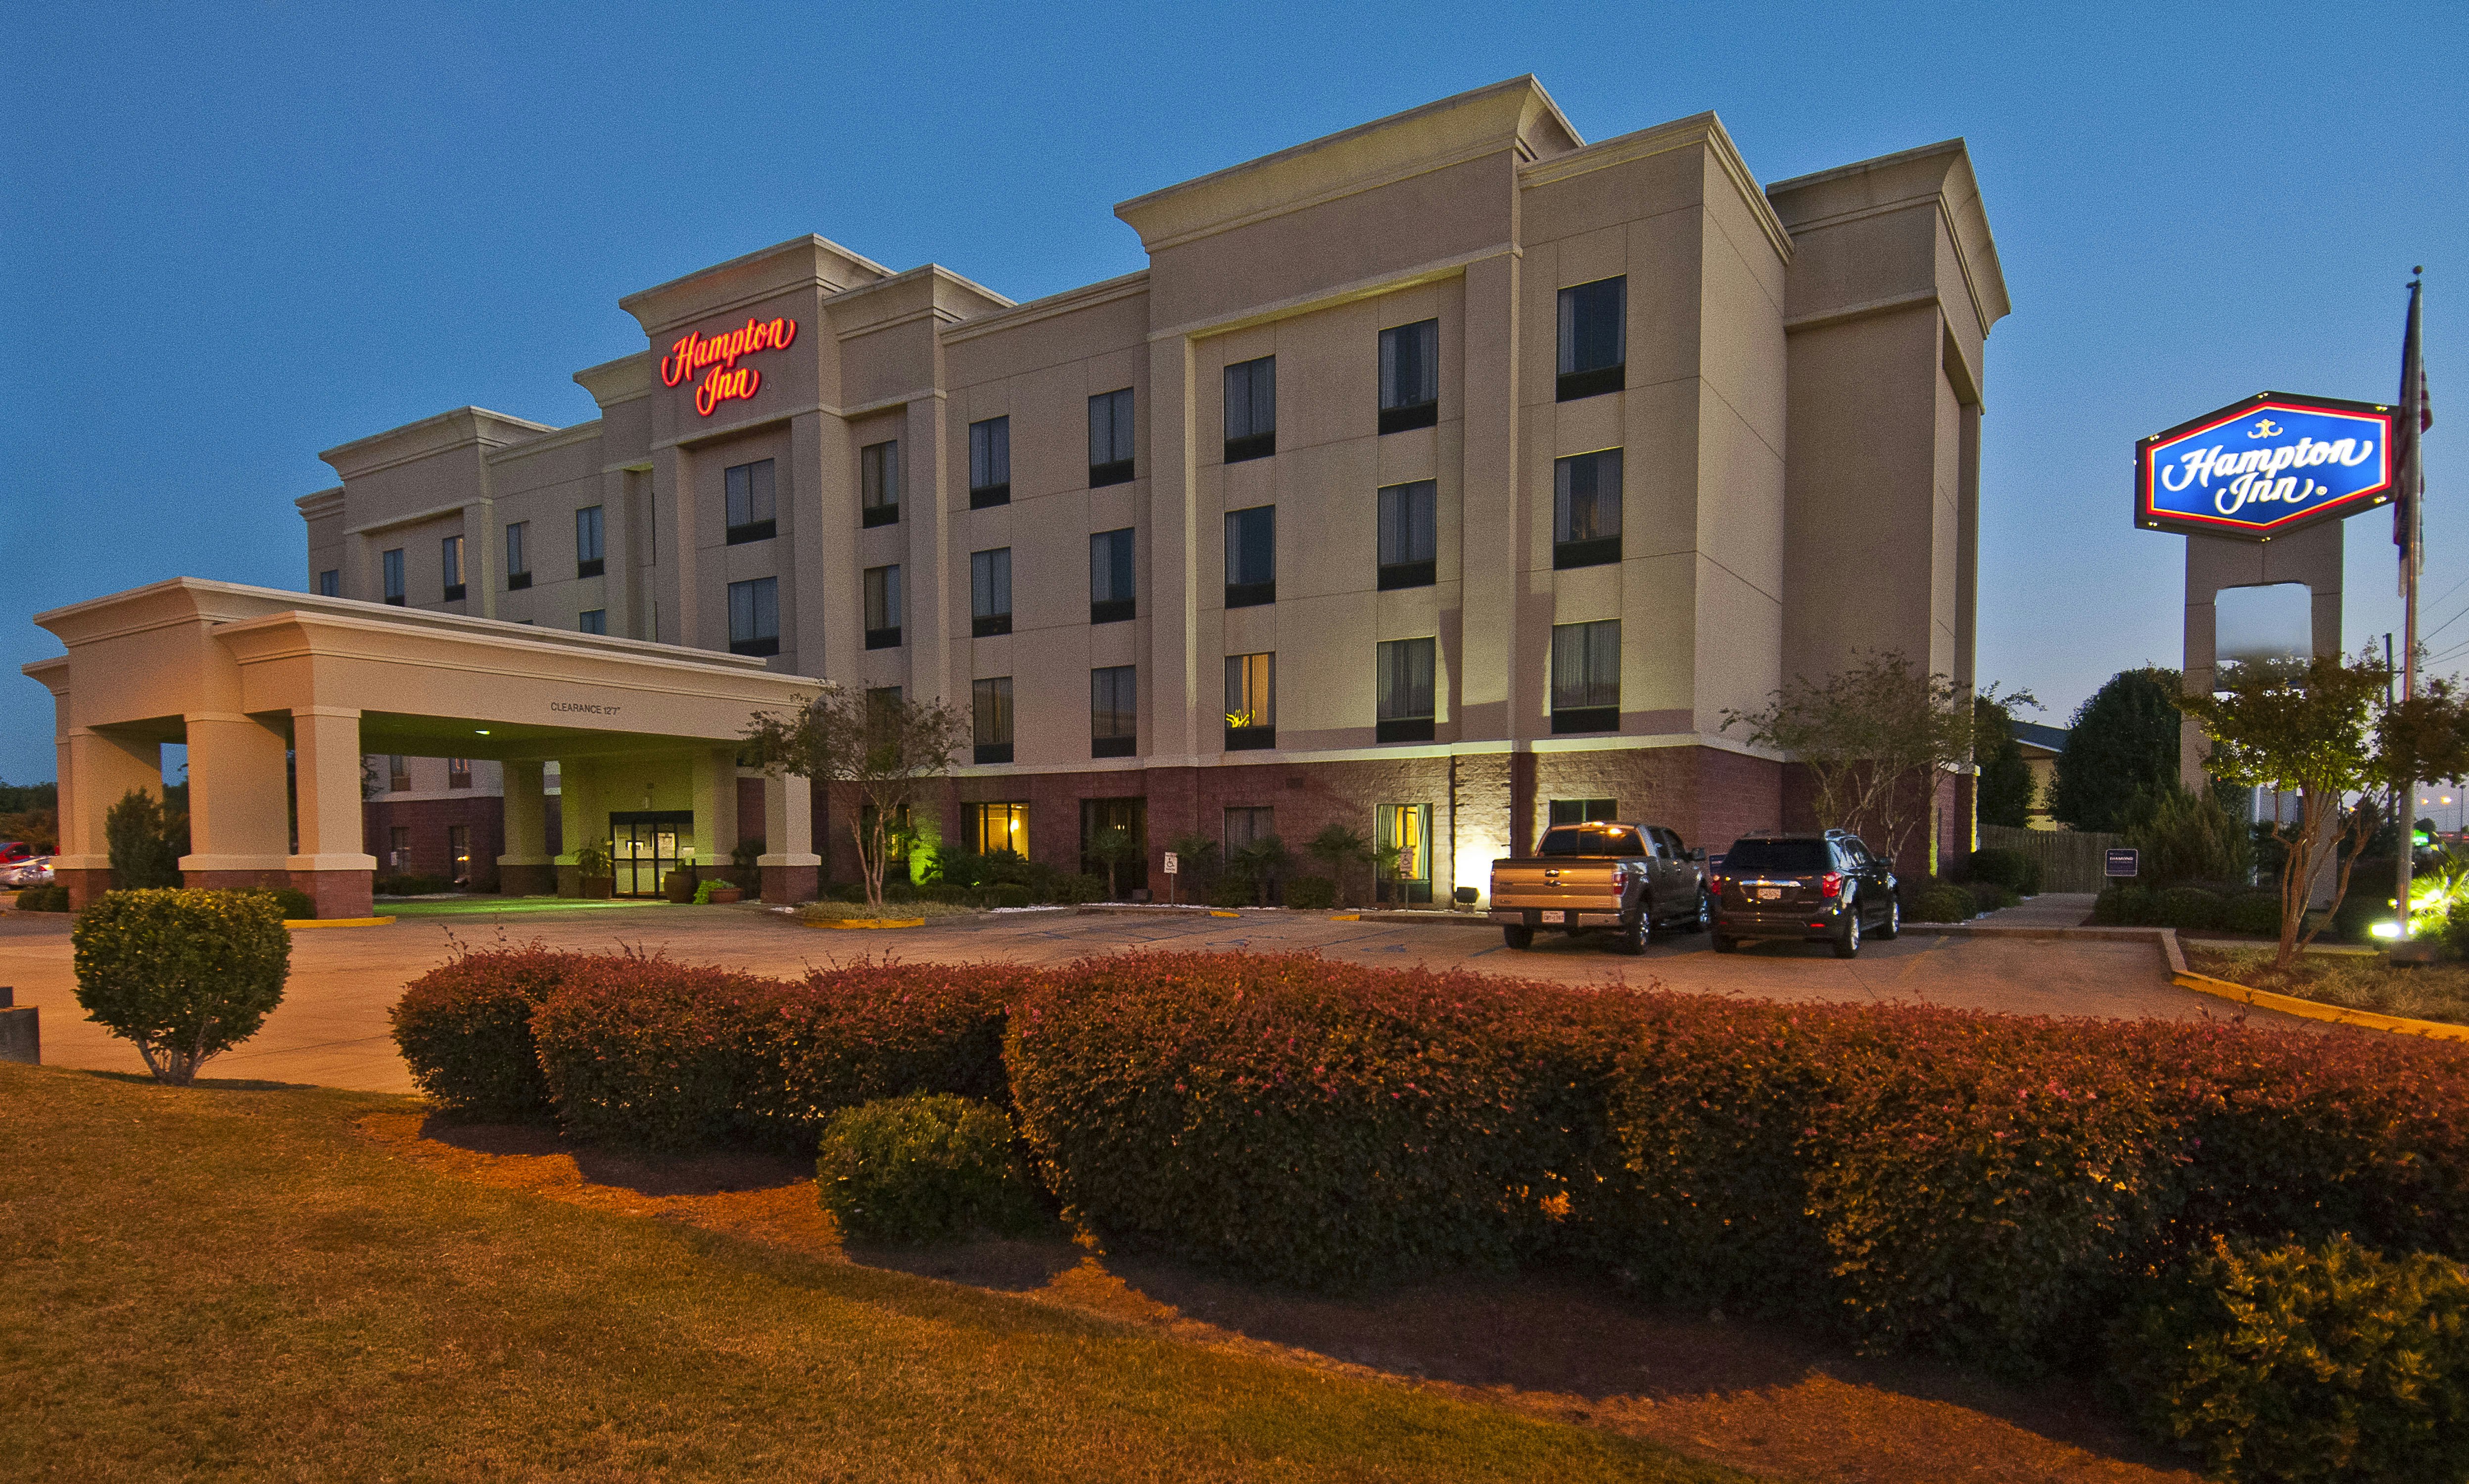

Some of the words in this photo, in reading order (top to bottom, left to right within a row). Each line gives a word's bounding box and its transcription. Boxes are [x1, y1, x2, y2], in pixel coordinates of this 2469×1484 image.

[661, 318, 796, 386] Hampton
[696, 364, 760, 416] Inn
[2161, 437, 2374, 491] Hampton
[2215, 472, 2315, 514] Inn
[550, 701, 602, 714] CLEARANCE
